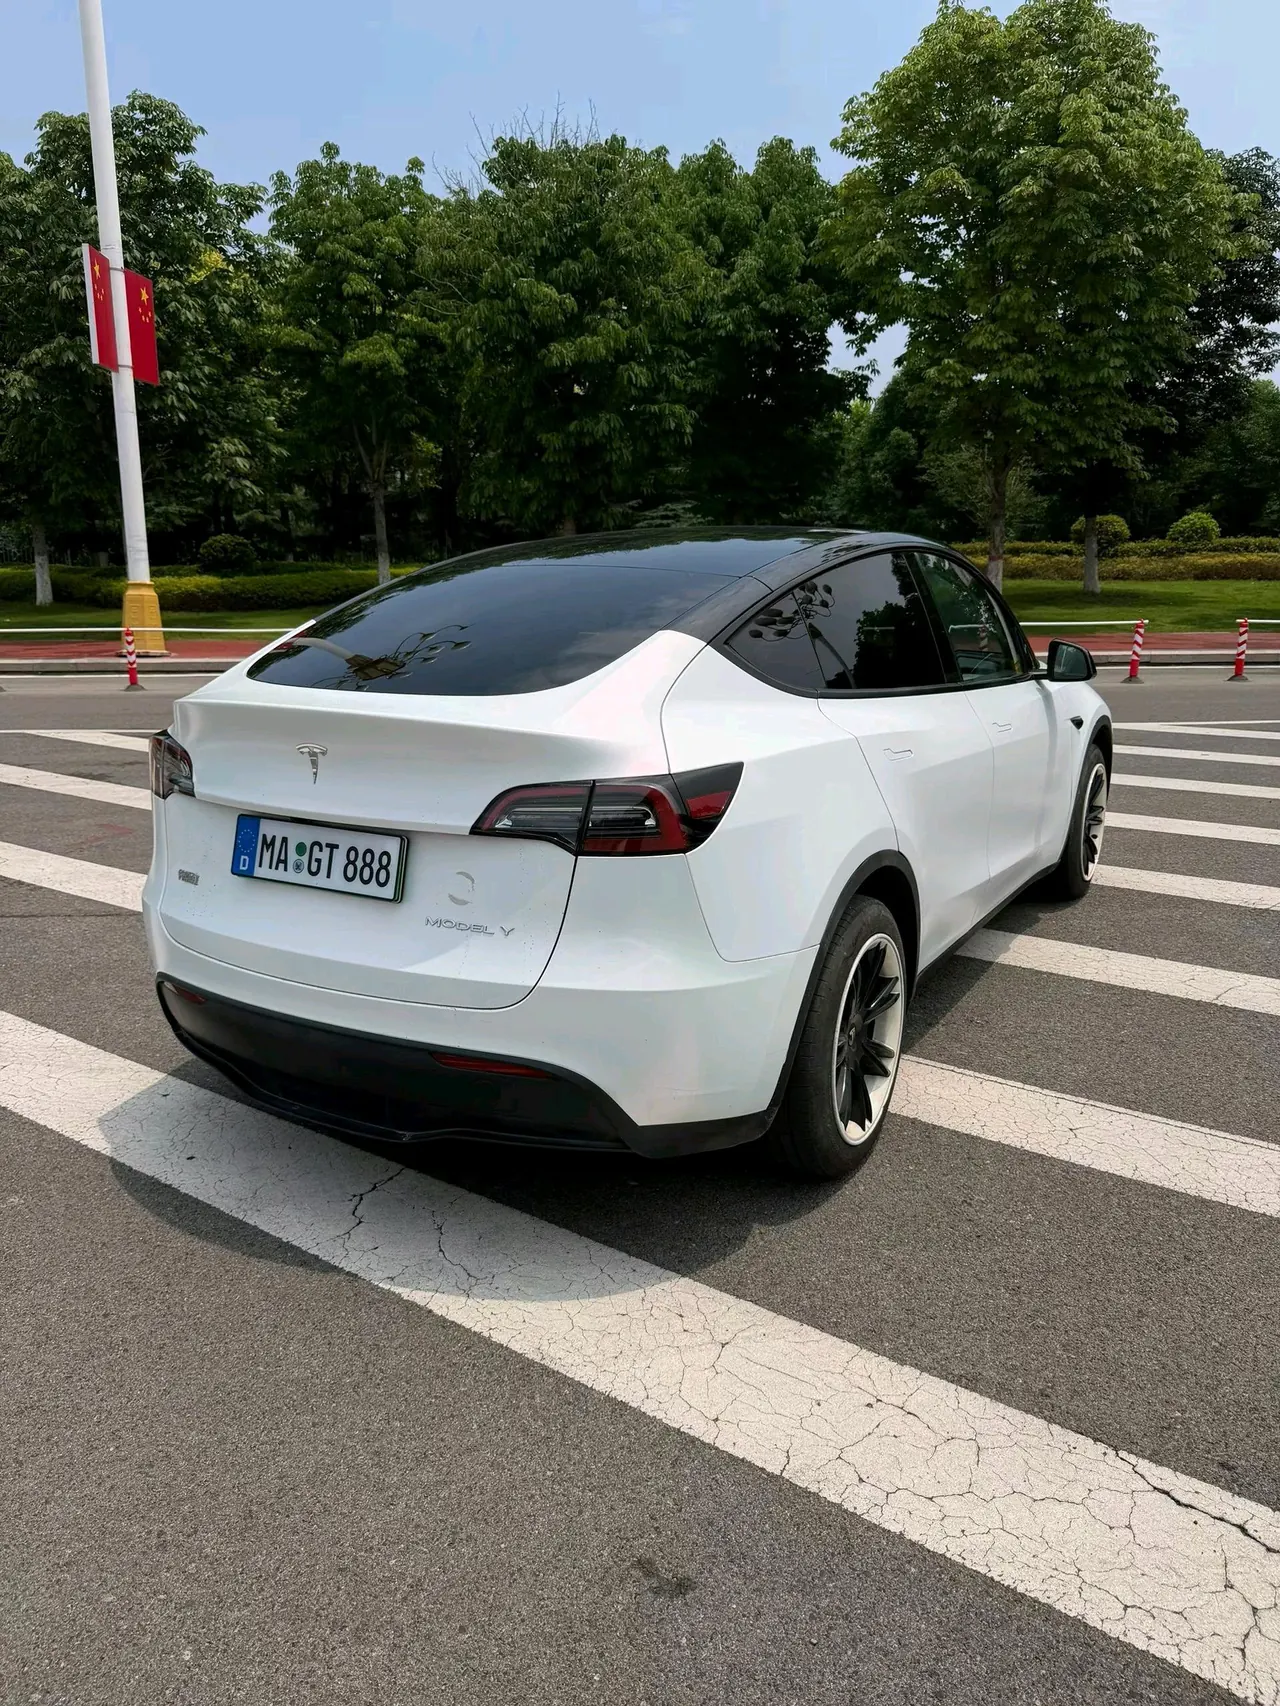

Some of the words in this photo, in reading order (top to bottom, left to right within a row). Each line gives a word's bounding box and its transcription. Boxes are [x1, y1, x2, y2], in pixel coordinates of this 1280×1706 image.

[239, 855, 249, 870] D
[258, 833, 289, 872] MA
[307, 841, 340, 879] GT
[343, 846, 392, 888] 888
[425, 916, 495, 936] MODEL
[500, 925, 515, 937] Y
